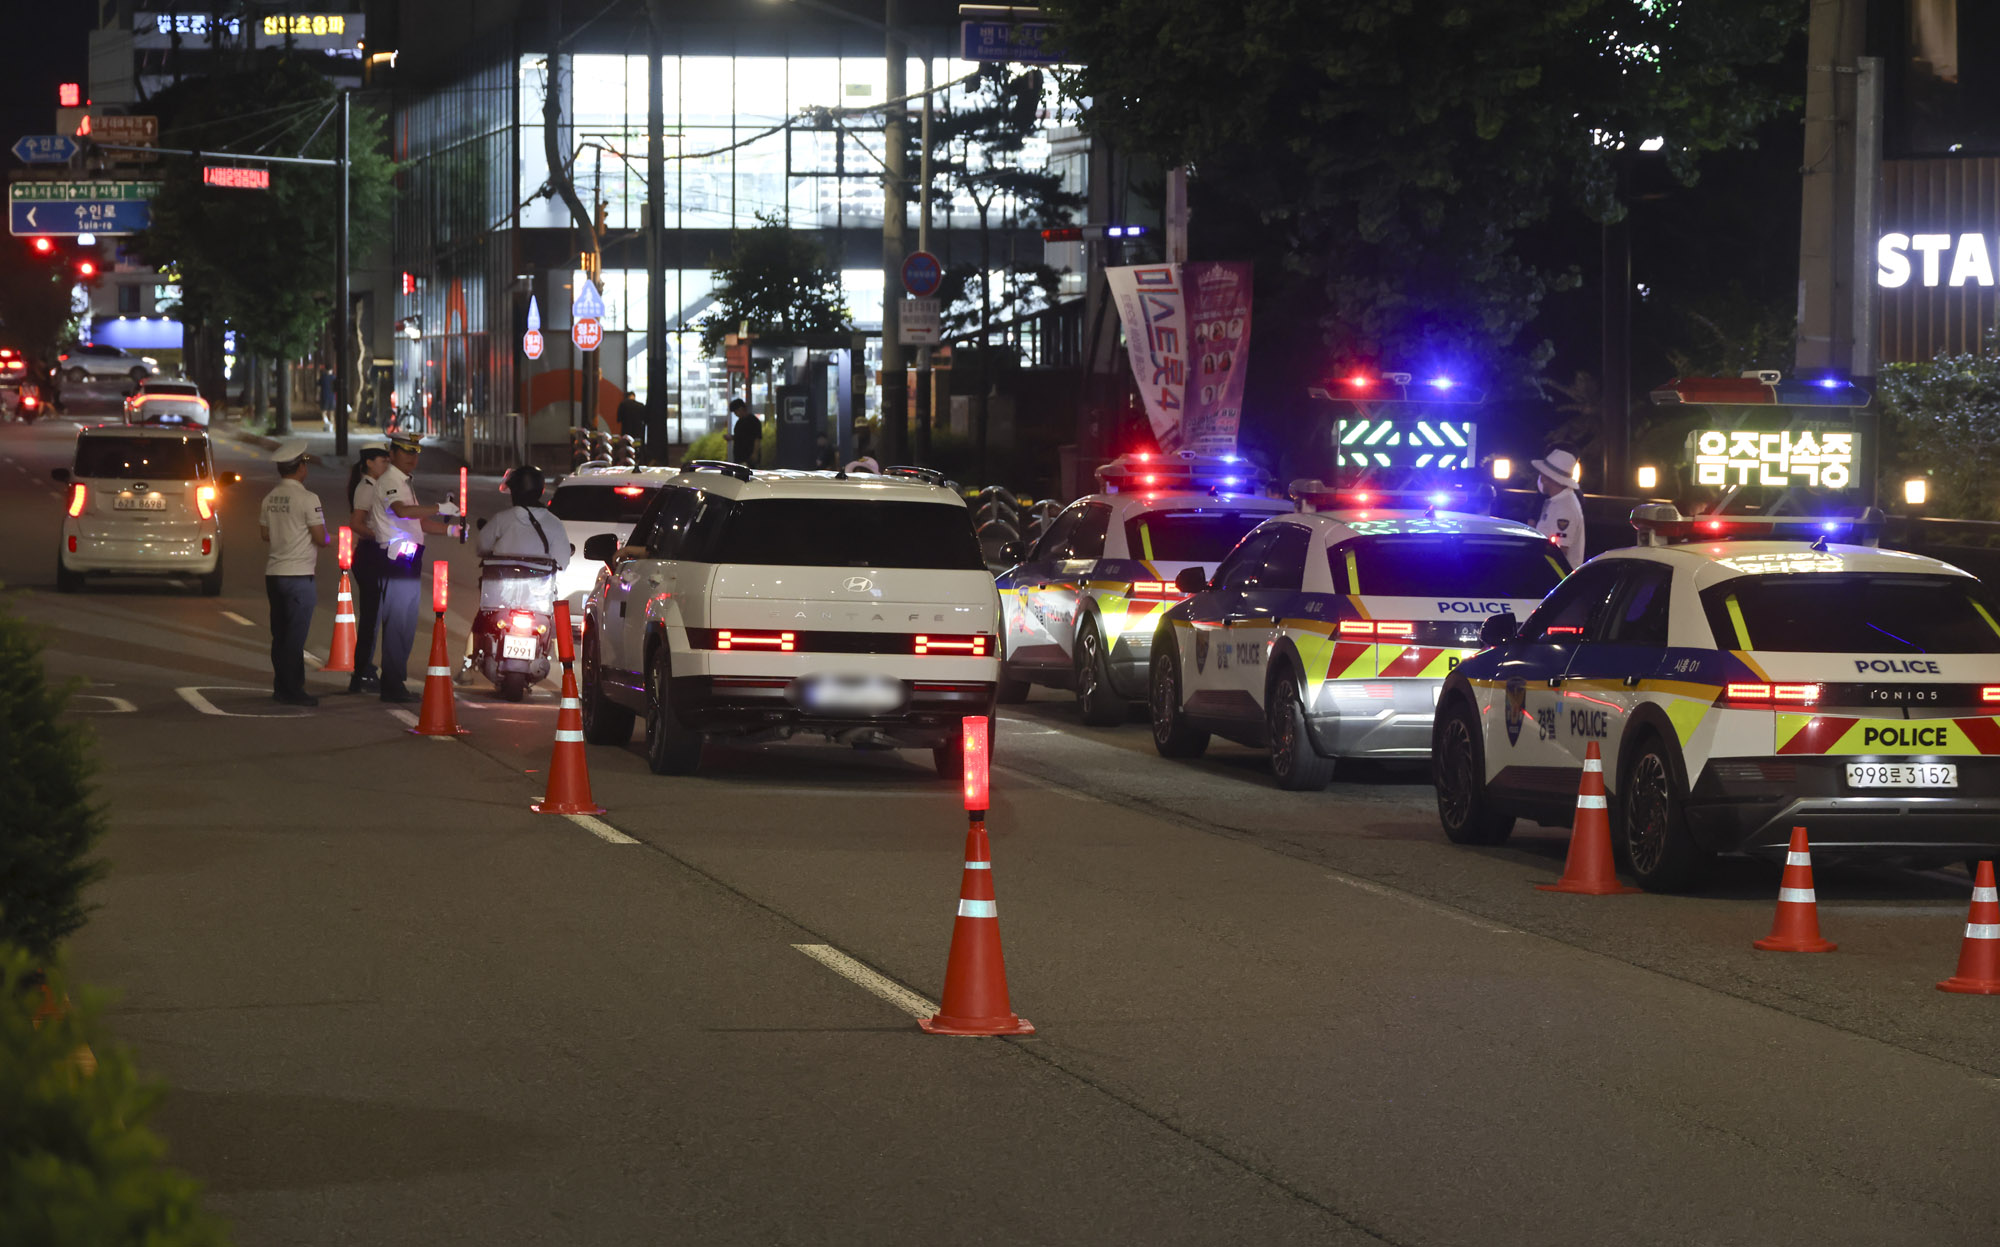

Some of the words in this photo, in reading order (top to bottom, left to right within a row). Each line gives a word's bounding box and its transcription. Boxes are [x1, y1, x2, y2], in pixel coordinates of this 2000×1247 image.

[26, 138, 65, 151] 수인로
[74, 204, 117, 220] 수인로
[78, 221, 113, 230] Suin-ro
[1878, 232, 2000, 288] STA
[577, 323, 598, 335] 정지
[577, 335, 598, 345] STOP
[1696, 430, 1852, 488] 음주단속중
[267, 505, 290, 514] POLICE
[1437, 602, 1512, 614] POLICE
[908, 613, 945, 622] FE
[1454, 627, 1481, 635] ION
[506, 646, 532, 657] 7991
[1236, 642, 1260, 665] POLICE
[1674, 659, 1690, 673] 시흥
[1688, 660, 1701, 673] 01
[1855, 660, 1941, 674] POLICE
[1870, 691, 1925, 700] IONIQ
[1930, 691, 1938, 700] 5
[1537, 706, 1556, 741] 경찰
[1570, 709, 1608, 738] POLICE
[1864, 727, 1947, 746] POLICE
[1854, 767, 1902, 784] 998로
[1905, 767, 1951, 784] 3152
